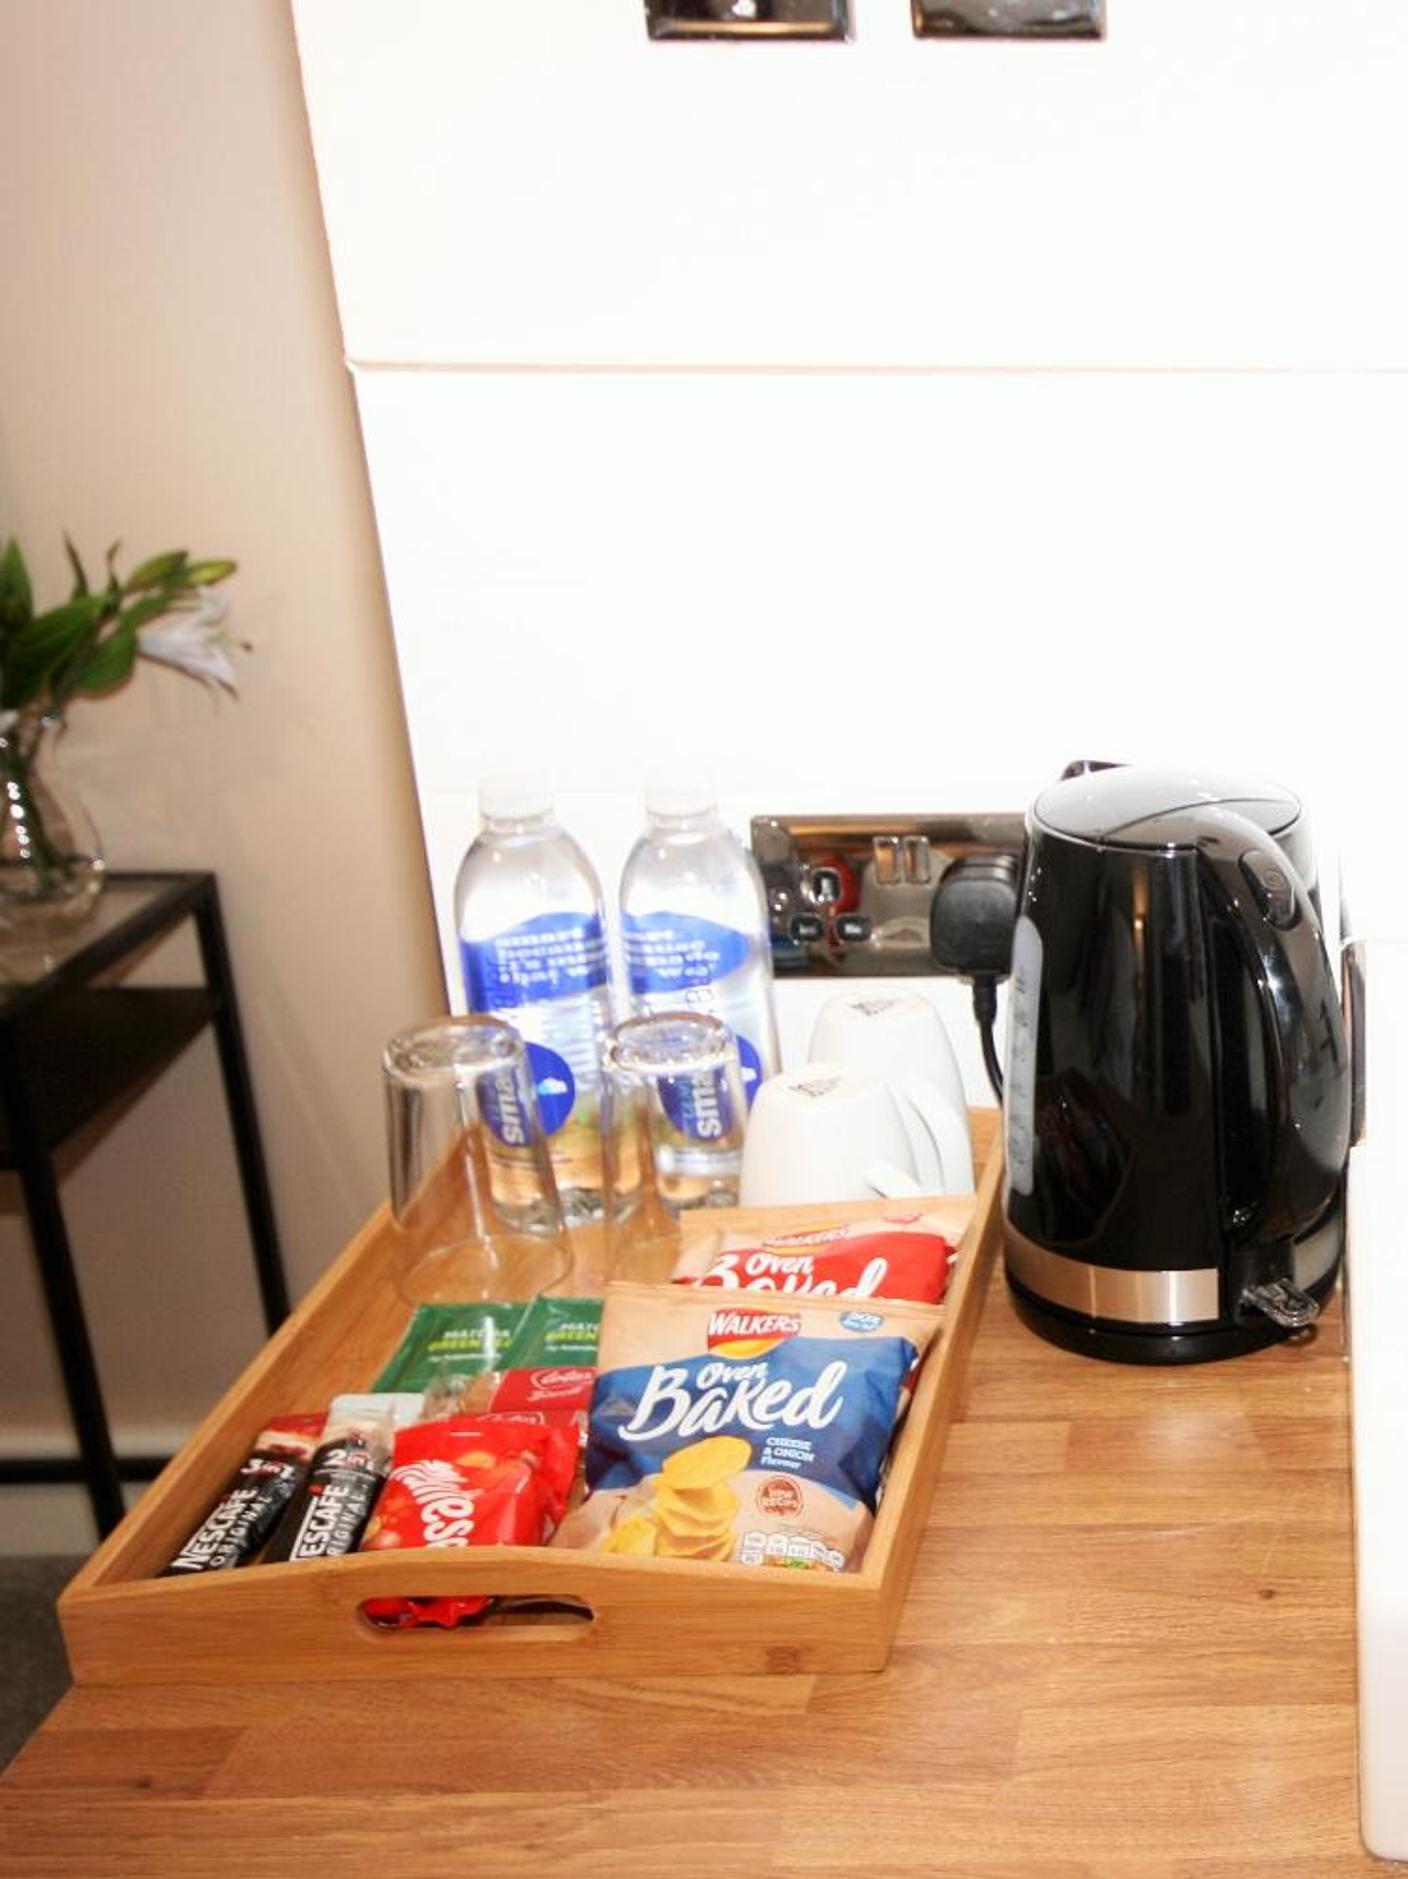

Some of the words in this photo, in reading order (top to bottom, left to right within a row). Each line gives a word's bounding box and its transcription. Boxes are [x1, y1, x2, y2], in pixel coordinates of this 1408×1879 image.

[745, 1252, 814, 1276] Oven
[708, 1311, 800, 1335] WALKERS
[696, 1362, 768, 1389] Oven
[617, 1360, 848, 1442] Baked
[773, 1447, 815, 1462] ONION
[326, 1483, 369, 1556] RIGINAL
